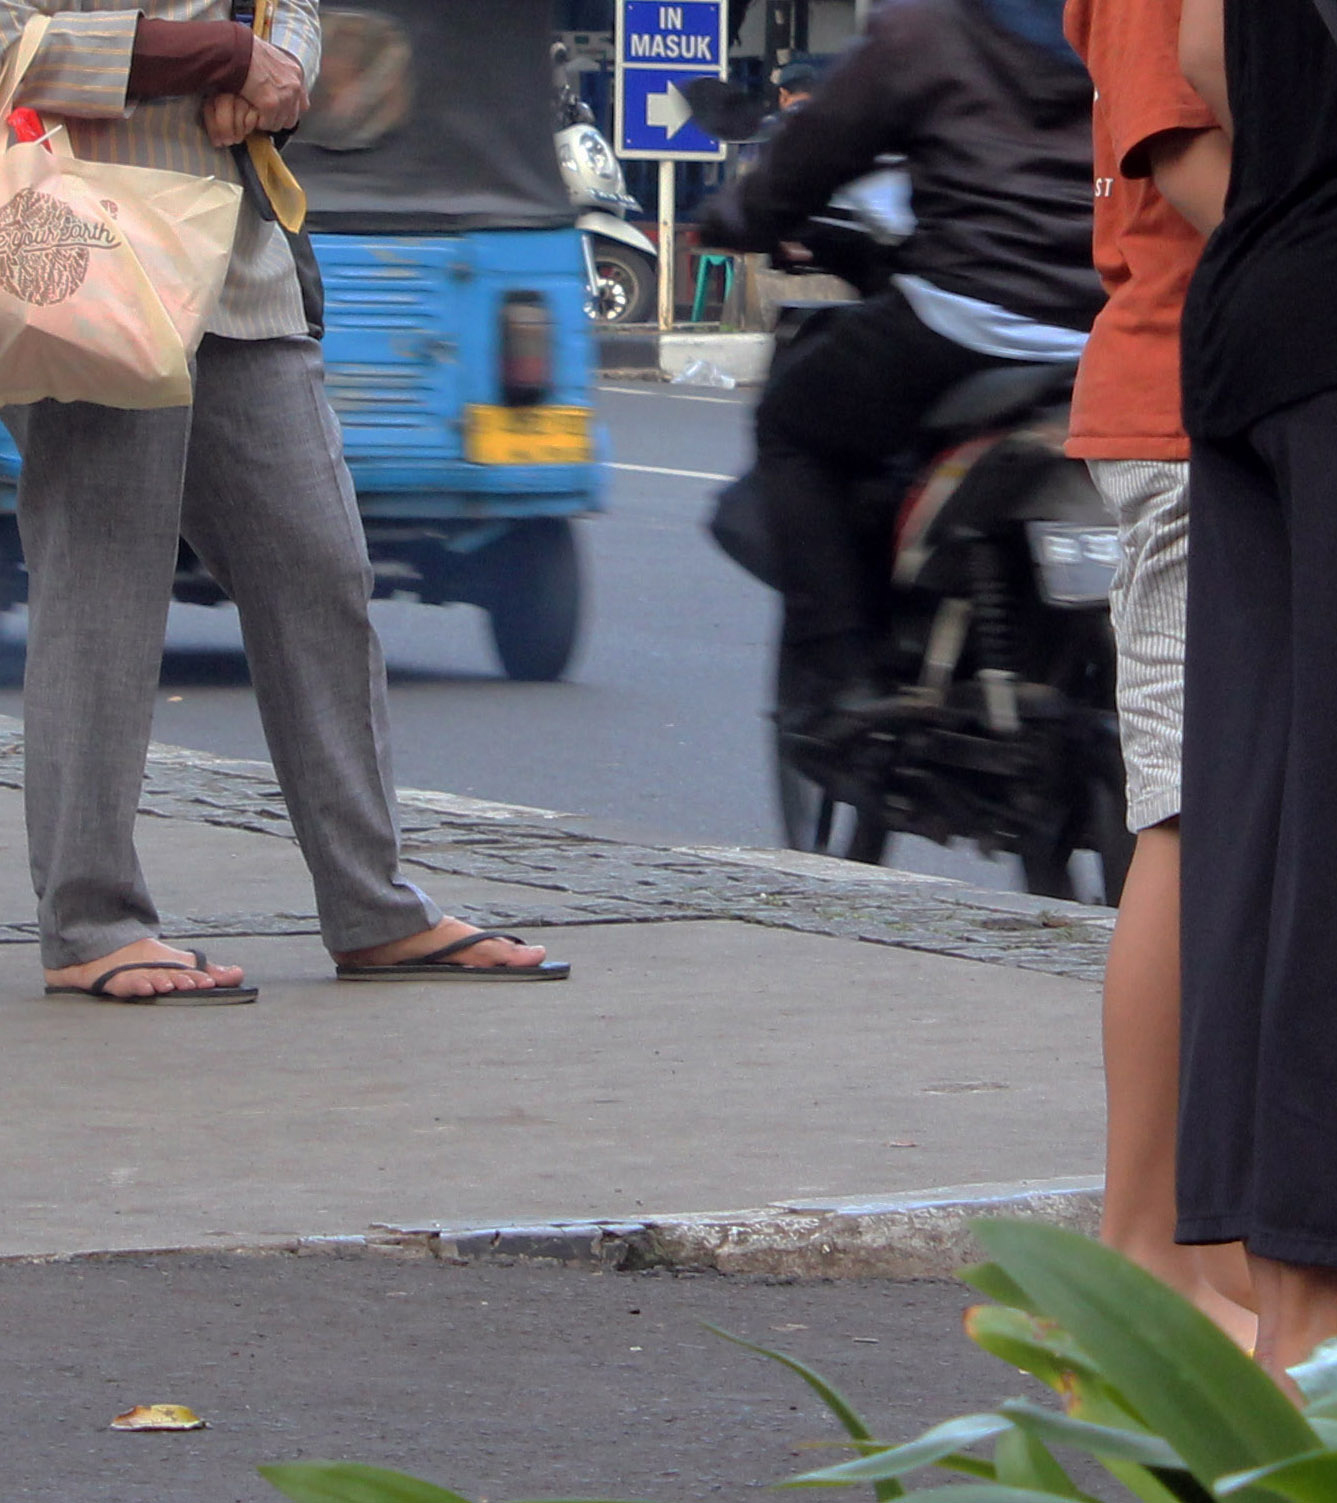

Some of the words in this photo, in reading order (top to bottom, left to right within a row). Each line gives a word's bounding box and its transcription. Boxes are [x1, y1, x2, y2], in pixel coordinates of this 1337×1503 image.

[658, 6, 683, 30] IN
[630, 34, 712, 61] MASUK
[10, 229, 59, 256] your
